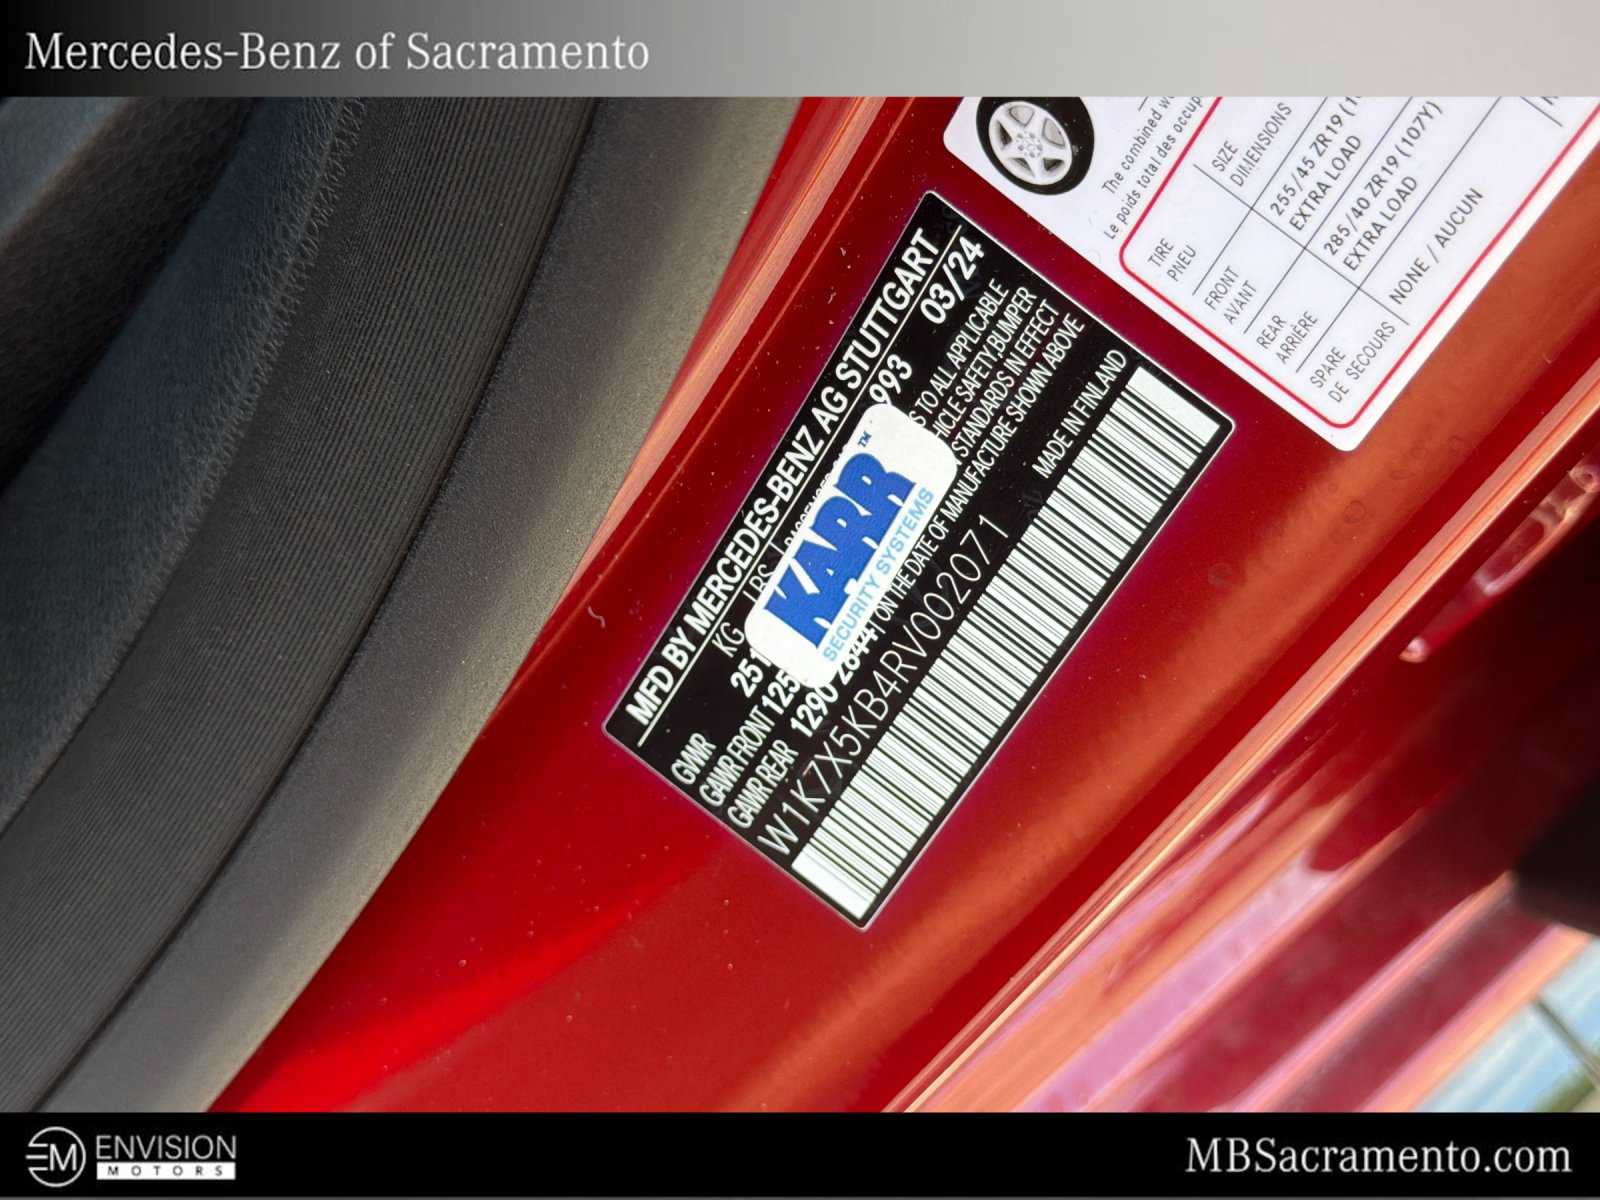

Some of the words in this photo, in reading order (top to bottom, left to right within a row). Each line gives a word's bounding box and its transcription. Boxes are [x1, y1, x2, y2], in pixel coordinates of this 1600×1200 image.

[1102, 170, 1126, 194] The
[1121, 107, 1164, 170] combined
[1105, 219, 1120, 241] Le
[1117, 188, 1143, 225] poids
[1138, 155, 1160, 190] total
[1157, 133, 1177, 159] des
[1212, 141, 1238, 172] SIZE
[1230, 102, 1292, 187] DIMENSIONS
[1270, 156, 1315, 216] 255/45
[1289, 182, 1332, 230] EXTRA
[1324, 136, 1361, 180] LOAD
[1324, 197, 1370, 255] 285/40
[1395, 101, 1442, 157] (107Y)
[1148, 238, 1174, 267] TIRE
[1167, 245, 1196, 281] PNEU
[1343, 222, 1387, 271] EXTRA
[1380, 176, 1417, 221] LOAD
[1389, 258, 1430, 304] NONE
[1435, 188, 1483, 248] AUCUN
[921, 237, 984, 323] 03/24
[1204, 266, 1238, 310] FRONT
[1224, 280, 1256, 325] AVANT
[915, 391, 938, 414] TO
[930, 367, 957, 396] ALL
[947, 279, 1008, 369] APPLICABLE
[1256, 316, 1286, 349] REAR
[1276, 311, 1318, 364] ARRIÈRE
[1310, 347, 1346, 388] SPARE
[1328, 382, 1349, 403] DE
[1344, 322, 1395, 380] SECOURS
[948, 371, 1014, 457] STANDARDS
[1004, 352, 1026, 376] IN
[1015, 299, 1058, 359] EFFECT
[1032, 429, 1073, 478] MADE
[1061, 412, 1085, 435] IN
[1073, 350, 1126, 418] FINLAND
[626, 666, 673, 728] MFD
[662, 627, 696, 669] BY
[684, 425, 824, 635] MERCEDES-BENZ
[812, 387, 847, 434] AG
[836, 228, 949, 389] STUTTGART
[874, 594, 899, 621] ON
[888, 568, 917, 599] THE
[904, 535, 938, 576] DATE
[928, 515, 949, 539] OF
[940, 416, 1017, 522] MANUFACTURE
[1006, 363, 1052, 422] SHOWN
[1042, 313, 1084, 369] ABOVE
[764, 452, 917, 649] KARR
[823, 574, 880, 661] SECURITY
[876, 488, 934, 575] SYSTEMS
[712, 623, 746, 657] KG
[758, 515, 1008, 854] W1K7X5KB4RV002071
[672, 733, 716, 784] GVWR
[700, 755, 744, 806] GAWR
[727, 705, 774, 765] FRONT
[728, 777, 773, 827] GAWR
[756, 740, 798, 787] REAR
[791, 686, 838, 737] 1290
